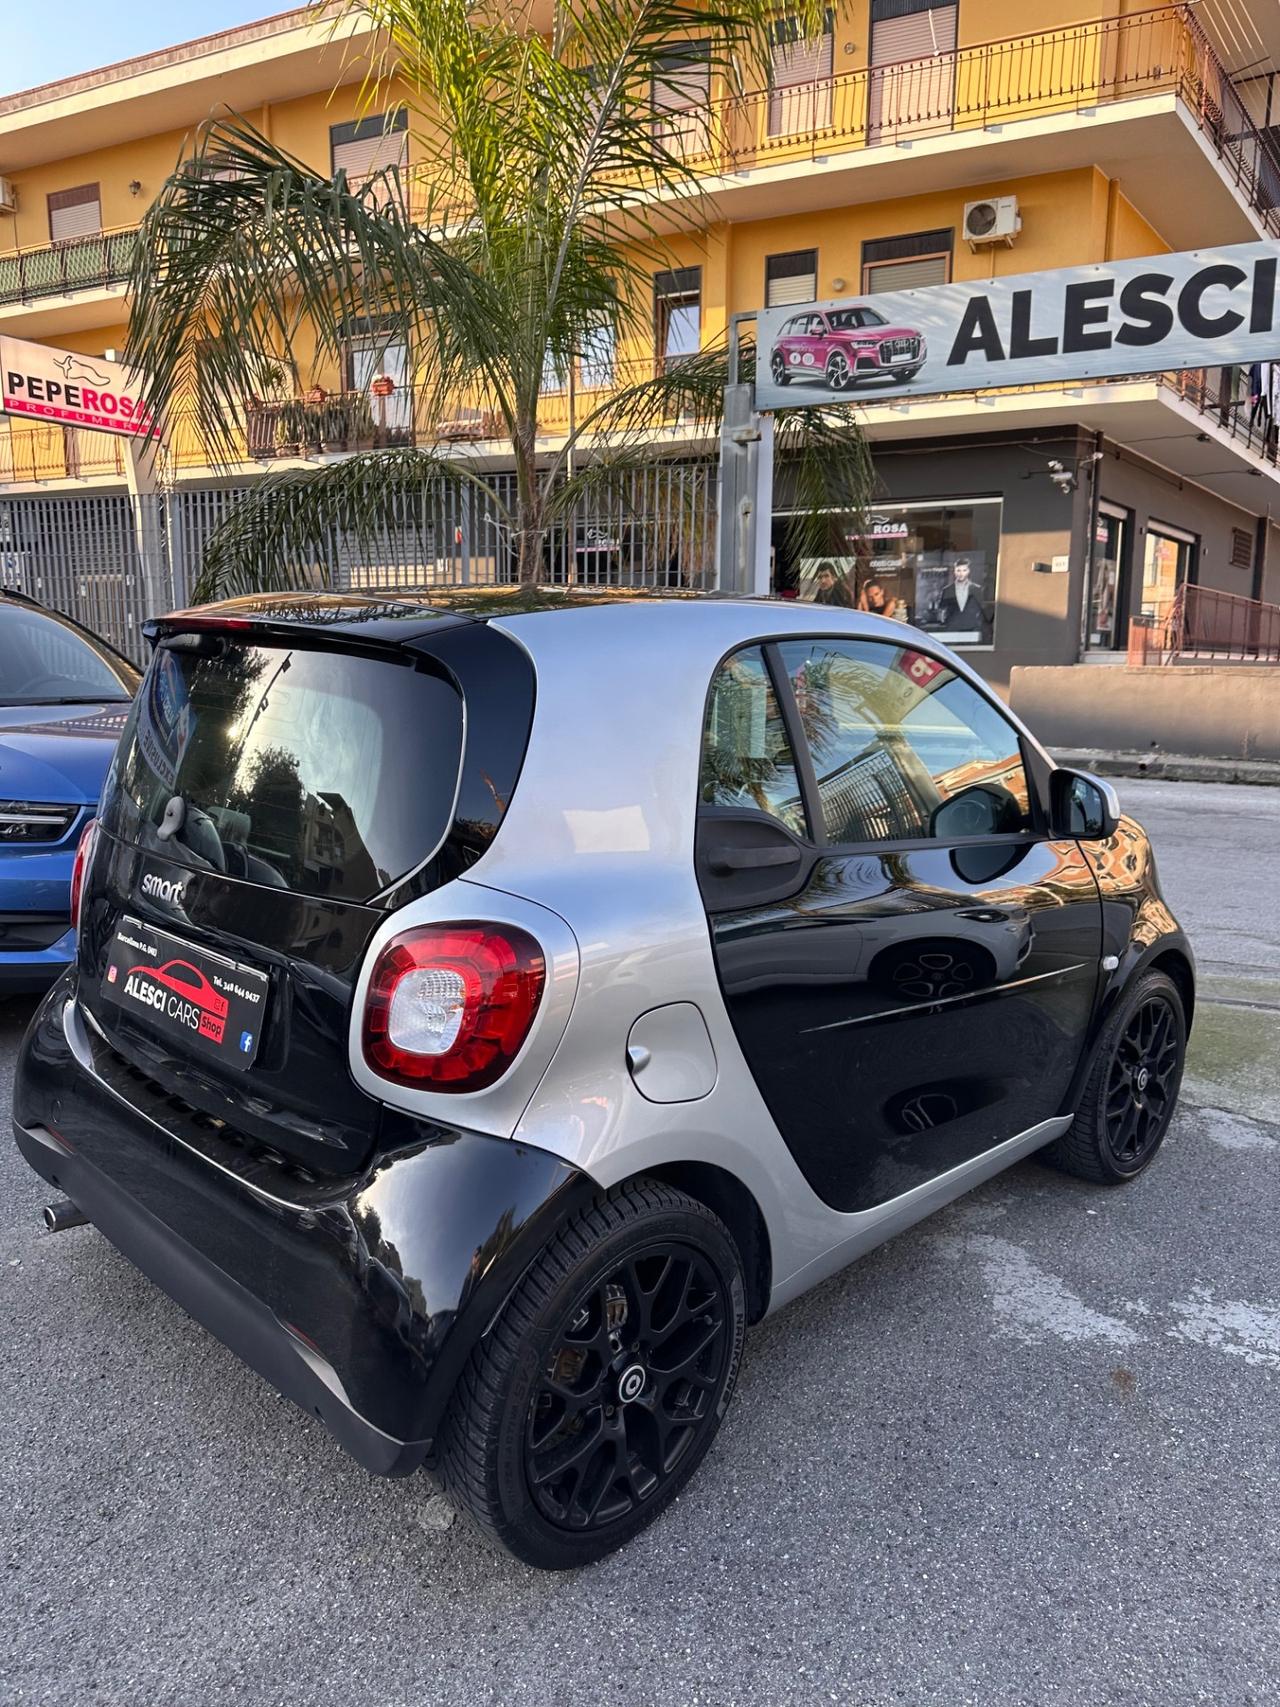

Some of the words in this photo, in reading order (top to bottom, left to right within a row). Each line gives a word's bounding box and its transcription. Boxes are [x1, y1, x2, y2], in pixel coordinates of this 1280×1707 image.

[946, 258, 1278, 366] ALESCI
[142, 873, 184, 904] smart
[123, 975, 167, 1012] ALESCI
[167, 996, 201, 1030] CARS
[222, 981, 234, 992] 348
[244, 990, 261, 1004] 9437
[201, 1015, 222, 1038] Shop
